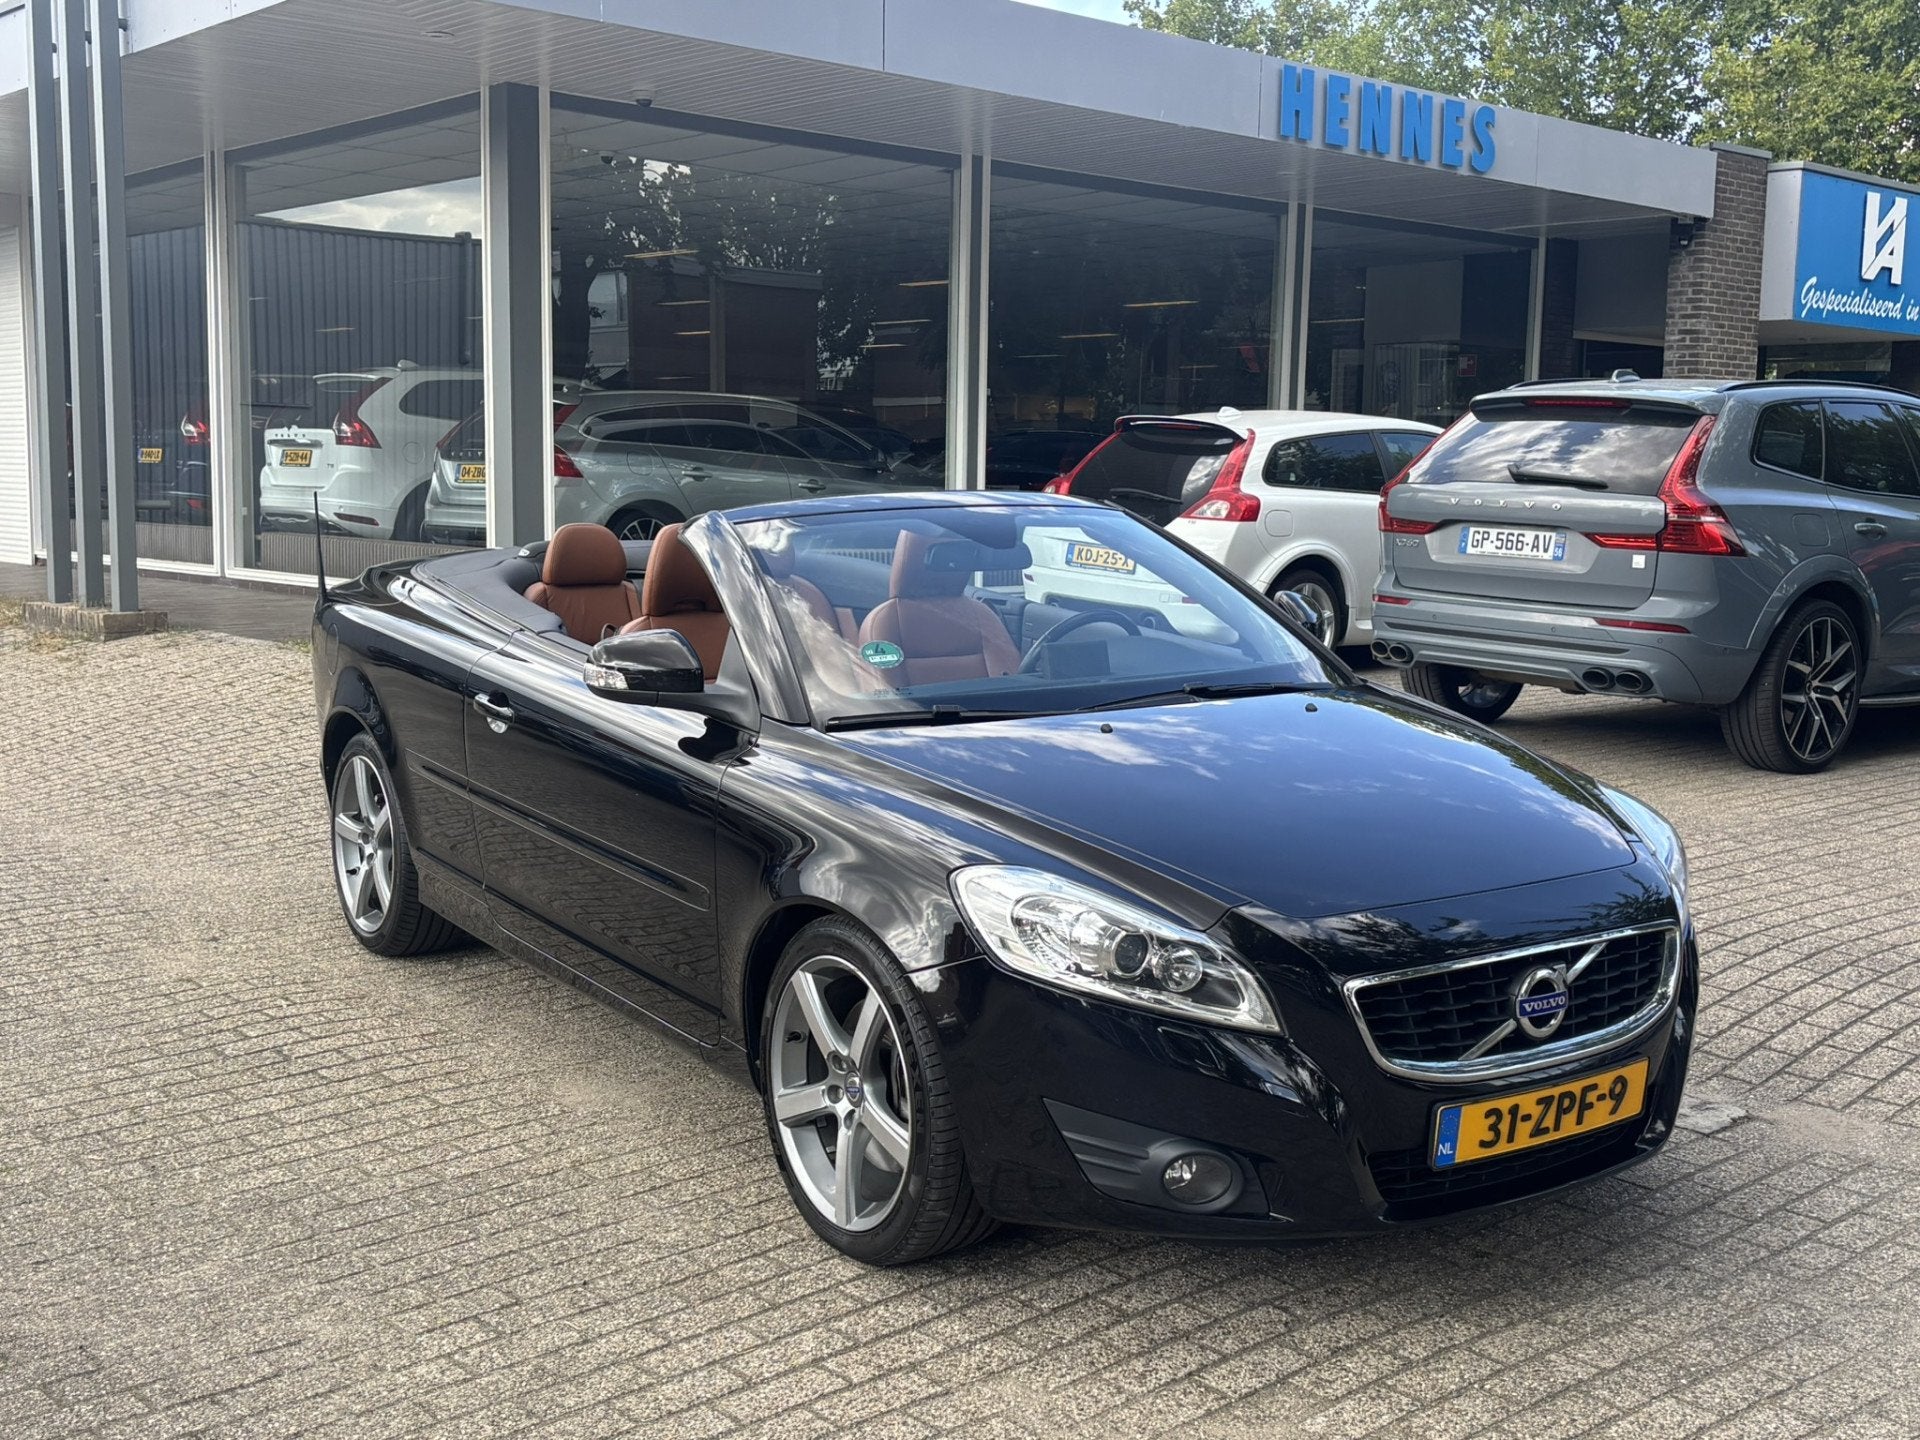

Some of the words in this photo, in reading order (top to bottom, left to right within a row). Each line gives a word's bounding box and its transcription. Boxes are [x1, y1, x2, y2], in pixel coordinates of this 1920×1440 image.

[1280, 64, 1496, 174] HENNES
[1800, 275, 1906, 320] Gespecialiseerd
[1906, 298, 1919, 322] in
[461, 465, 486, 479] 04-ZBG
[1450, 497, 1563, 511] VOLVO
[1470, 530, 1553, 554] GP-566-AV
[1553, 546, 1563, 557] 56
[1522, 995, 1566, 1013] VOLVO
[1437, 1142, 1454, 1156] NL
[1478, 1074, 1629, 1150] 31-ZPF-9
